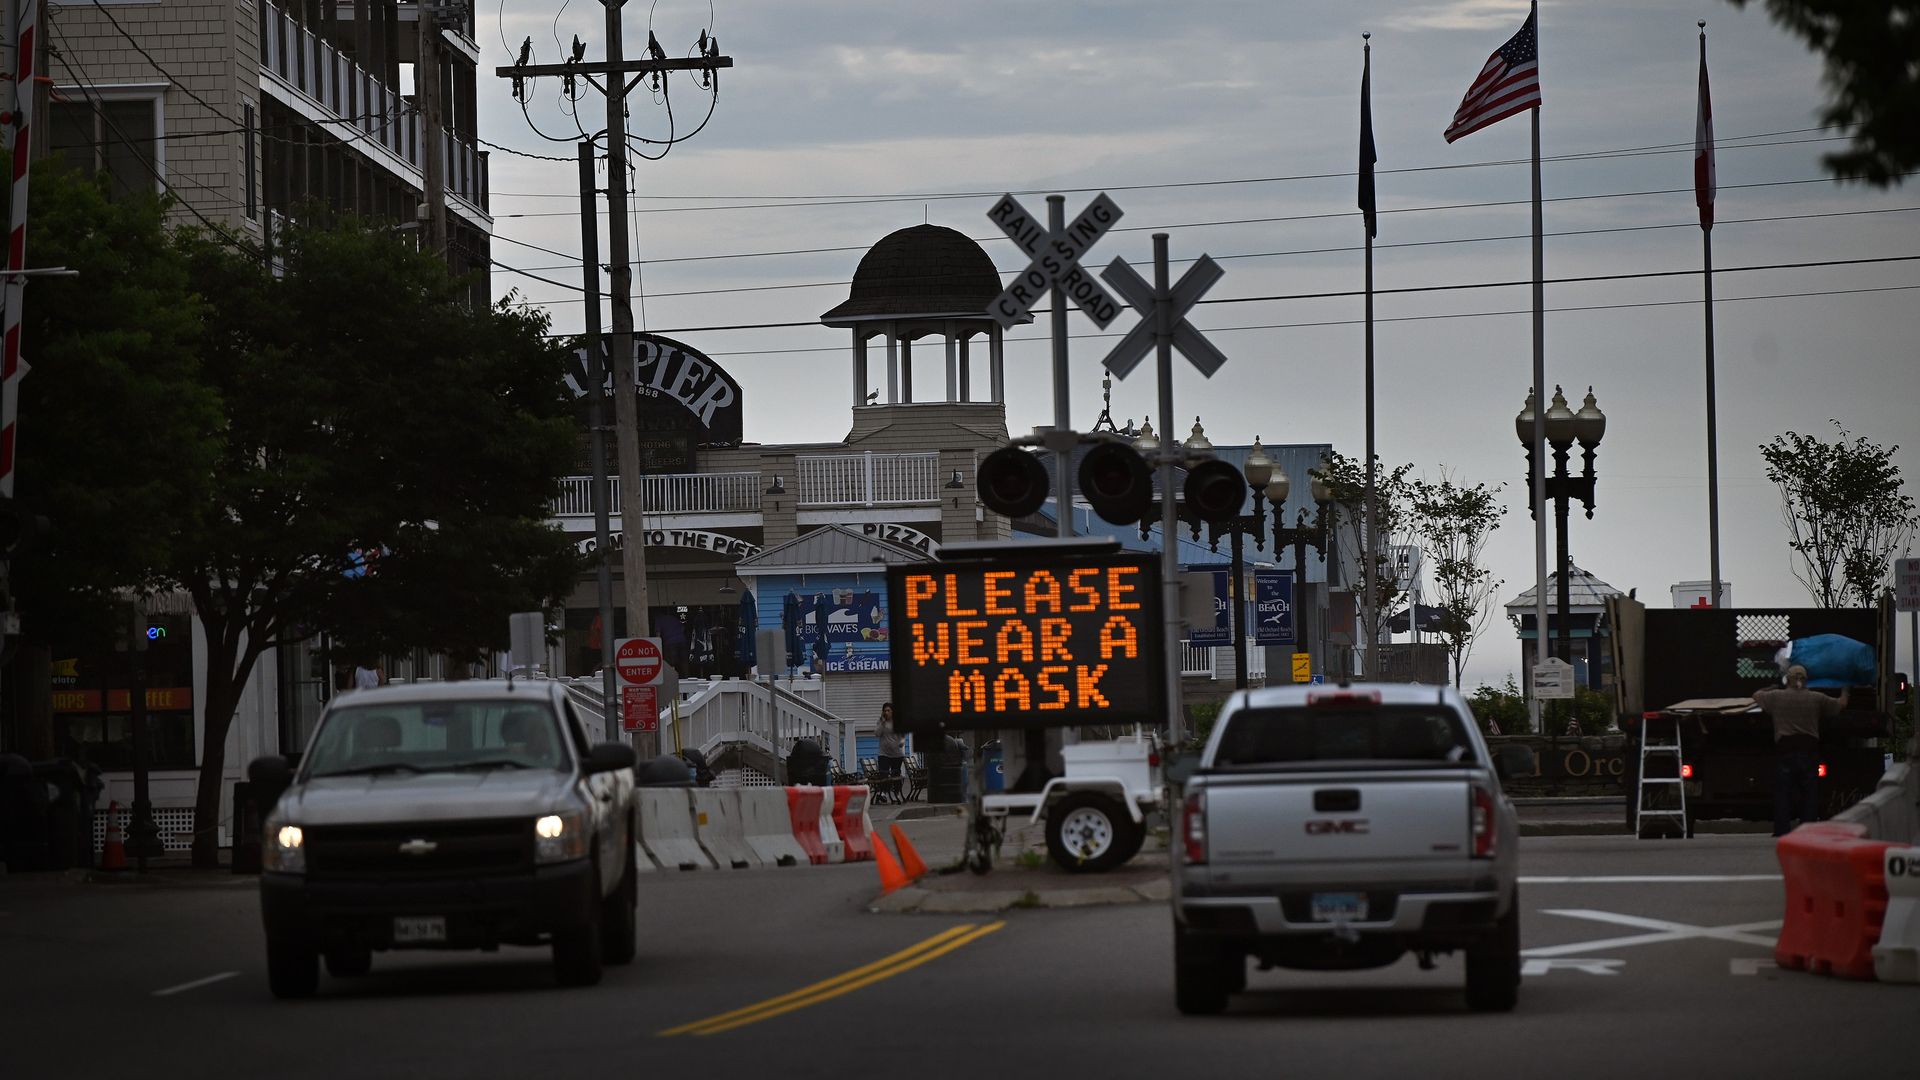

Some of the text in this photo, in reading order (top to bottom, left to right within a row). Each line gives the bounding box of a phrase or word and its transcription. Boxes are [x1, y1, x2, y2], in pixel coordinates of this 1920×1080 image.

[994, 201, 1115, 322] RAIL ROAD
[999, 205, 1112, 318] CROSSING
[633, 339, 734, 430] PIER
[643, 531, 665, 545] TO
[670, 531, 708, 548] THE
[863, 523, 930, 552] PIZZA
[905, 566, 1141, 619] PLEASE
[1258, 599, 1290, 612] BEACH
[147, 627, 166, 639] en
[911, 615, 1138, 667] WEAR A
[622, 647, 655, 656] DO NOT
[626, 668, 652, 676] ENTER
[826, 661, 889, 671] ICE CREAM
[949, 663, 1111, 713] MASK
[1305, 820, 1369, 835] GMC
